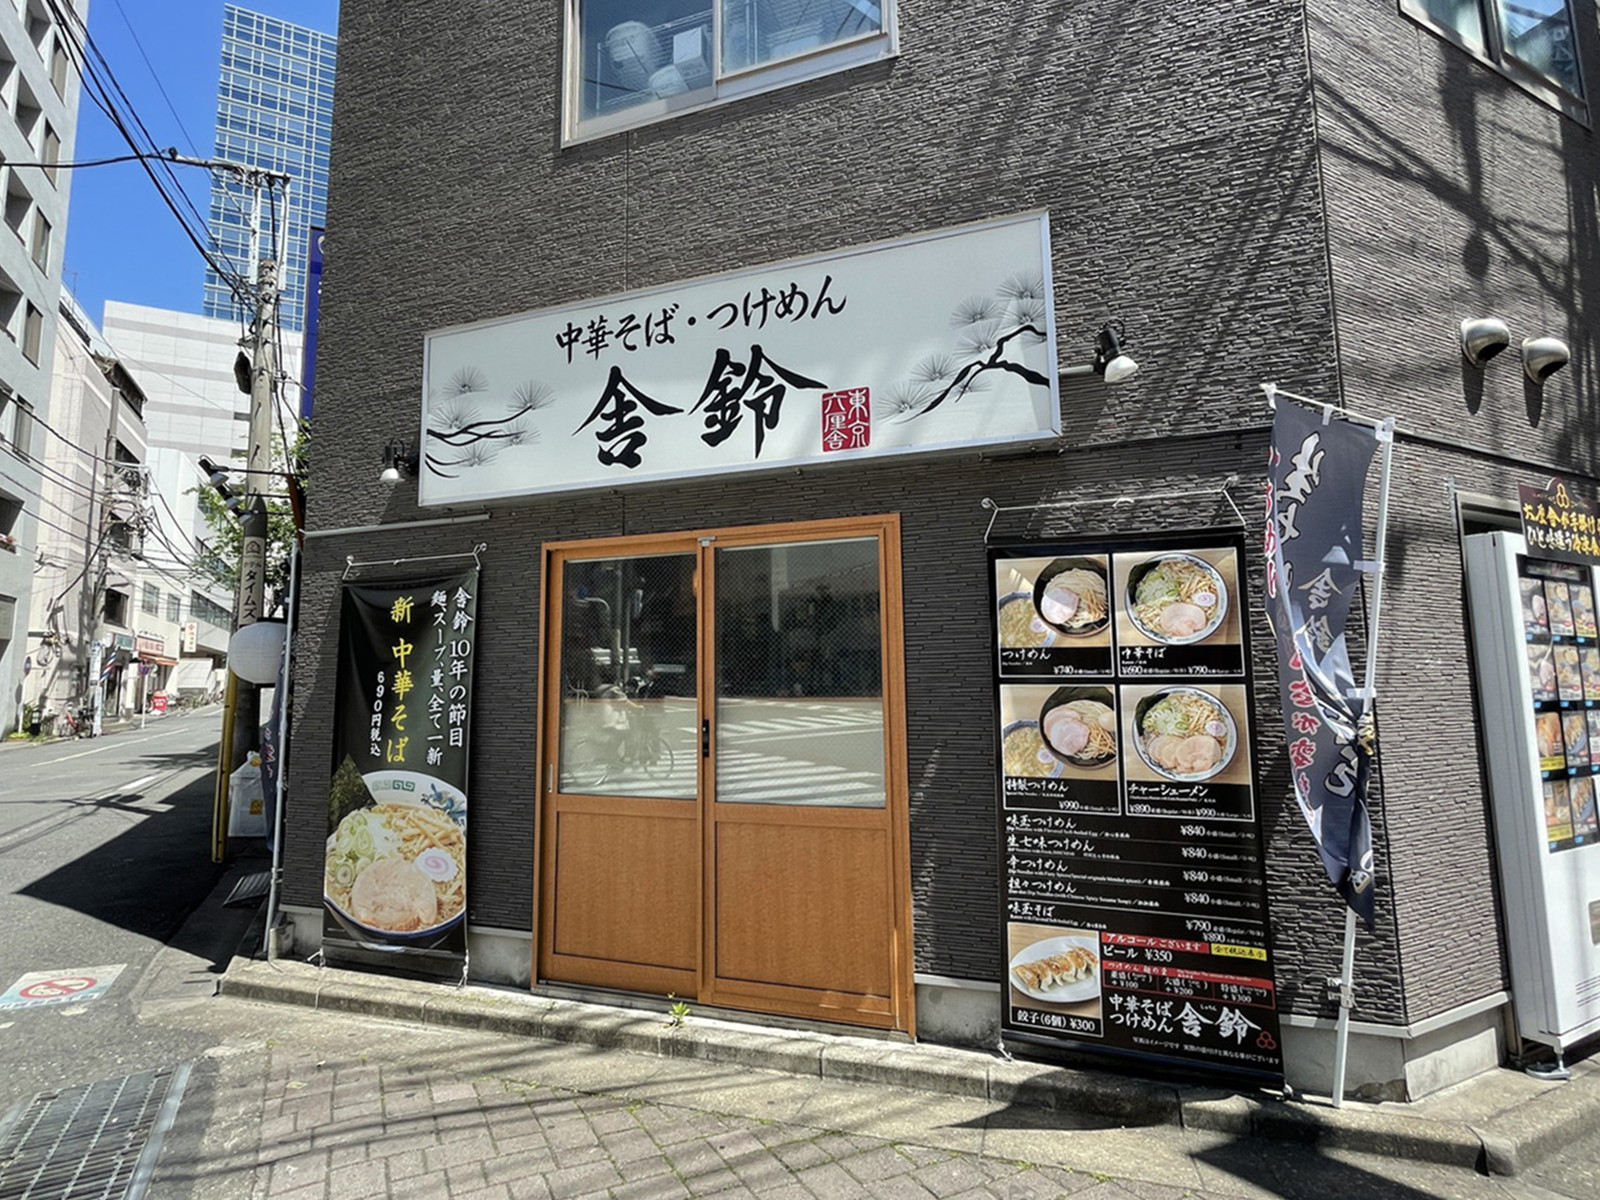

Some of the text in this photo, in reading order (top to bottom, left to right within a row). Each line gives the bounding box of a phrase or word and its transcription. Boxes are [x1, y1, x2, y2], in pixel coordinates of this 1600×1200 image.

[556, 276, 847, 364] 中華そば・つけめん
[572, 344, 828, 469] 舎鈴
[823, 393, 848, 449] 六厘舎
[848, 389, 869, 447] 東京
[1002, 648, 1051, 660] つけめん
[1121, 647, 1166, 659] 中華そば
[1128, 783, 1208, 797] チャーシューメン
[1006, 814, 1077, 829] 味玉つけめん
[1007, 855, 1068, 872] 辛つけめん
[1007, 901, 1055, 917] 味玉そば
[1106, 933, 1156, 946] アルコール
[1103, 944, 1173, 963] ビール ¥350
[1109, 994, 1174, 1017] 中華そば
[1070, 1018, 1095, 1032] ¥300
[1109, 1012, 1174, 1034] つけめん
[1173, 1002, 1263, 1045] 舎鈴
